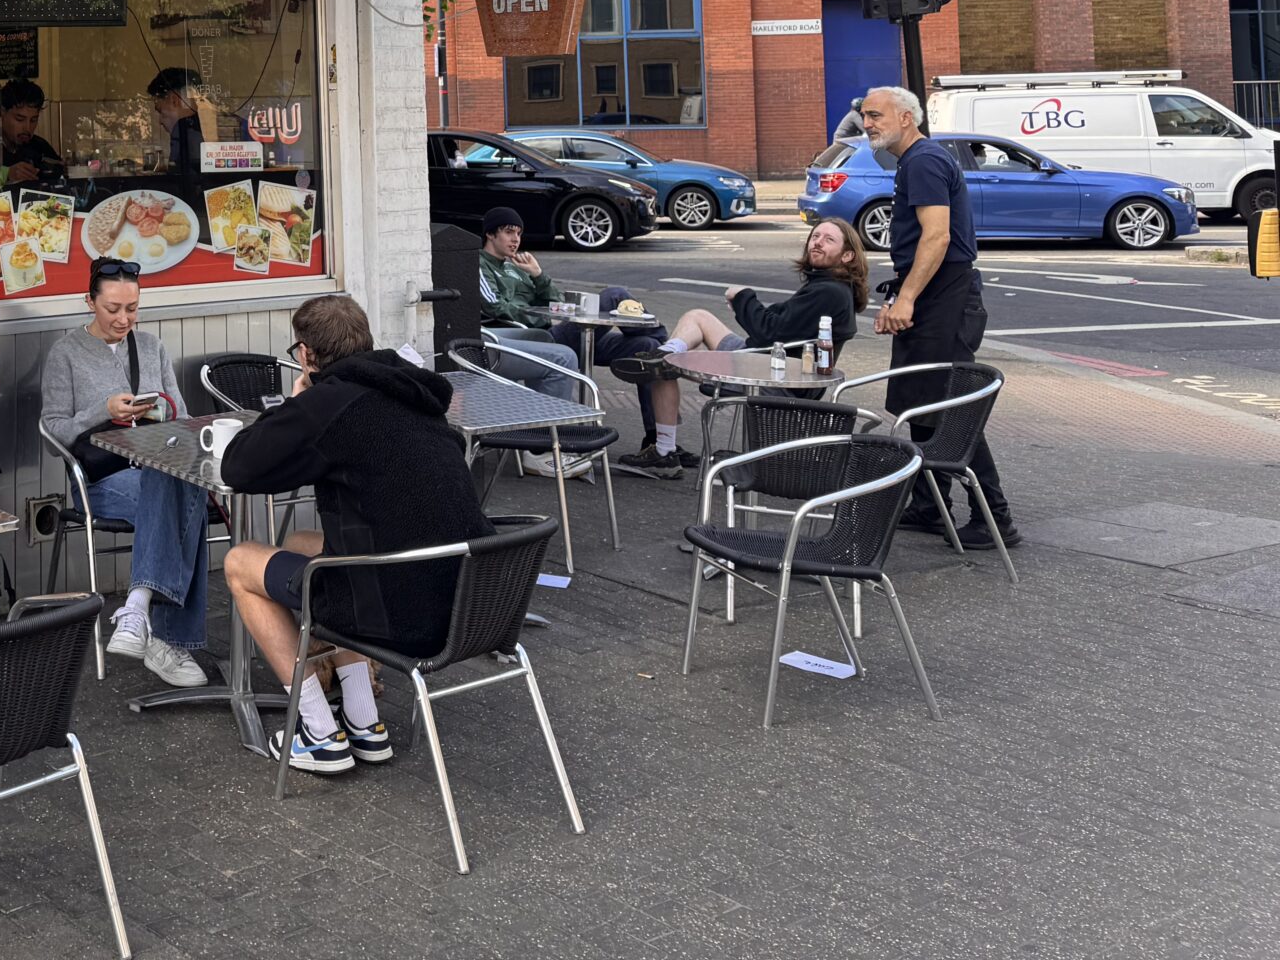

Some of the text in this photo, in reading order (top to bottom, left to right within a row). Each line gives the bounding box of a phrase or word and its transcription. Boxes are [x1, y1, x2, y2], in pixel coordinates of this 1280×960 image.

[752, 25, 798, 33] HARLEYFORD
[193, 84, 222, 95] KEBAB
[1020, 110, 1086, 129] TBG
